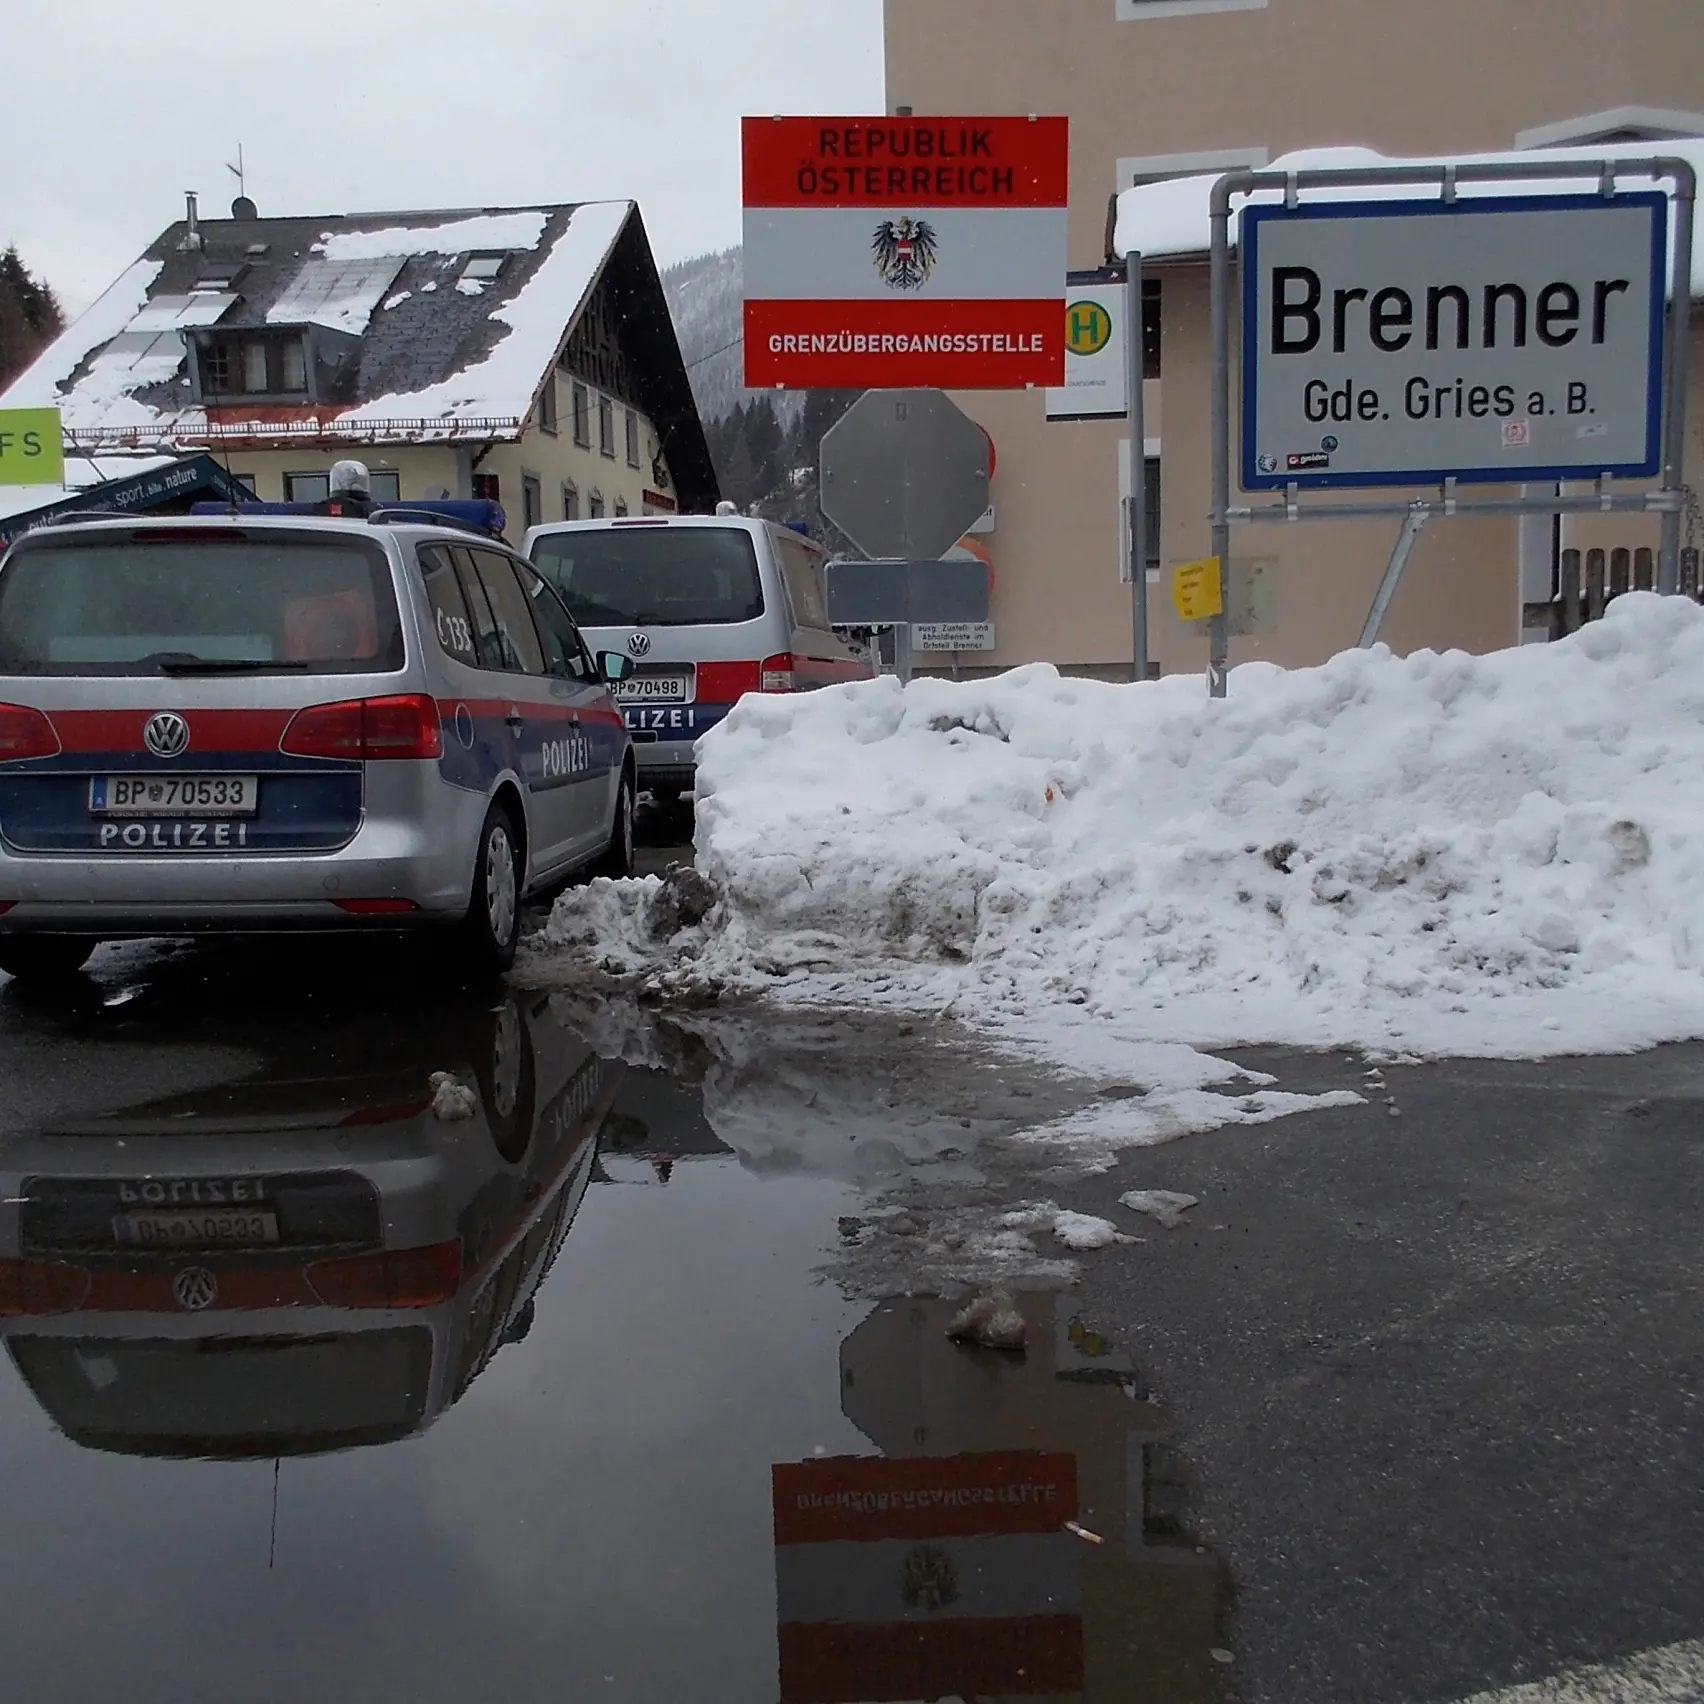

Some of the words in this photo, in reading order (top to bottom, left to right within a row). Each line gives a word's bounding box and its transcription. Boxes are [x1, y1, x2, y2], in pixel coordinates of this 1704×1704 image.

[819, 128, 993, 158] REPUBLIK
[796, 158, 1014, 195] ÖSTERREICH
[1271, 266, 1630, 355] Brenner
[768, 330, 1043, 353] GRENZÜBERGANGSSTELLE
[1072, 311, 1098, 345] H
[1303, 379, 1390, 422] Gde.
[1404, 376, 1515, 420] Gries
[1527, 391, 1555, 416] a.
[1566, 381, 1596, 415] B.
[165, 468, 198, 489] nature
[446, 616, 471, 651] 133
[953, 641, 983, 649] Brenner
[610, 681, 626, 694] BP
[637, 681, 678, 695] 70498
[624, 709, 694, 728] LIZEI
[541, 736, 589, 778] POLIZEI
[114, 780, 146, 805] BP
[166, 780, 244, 805] 70533
[100, 823, 247, 847] POLIZEI
